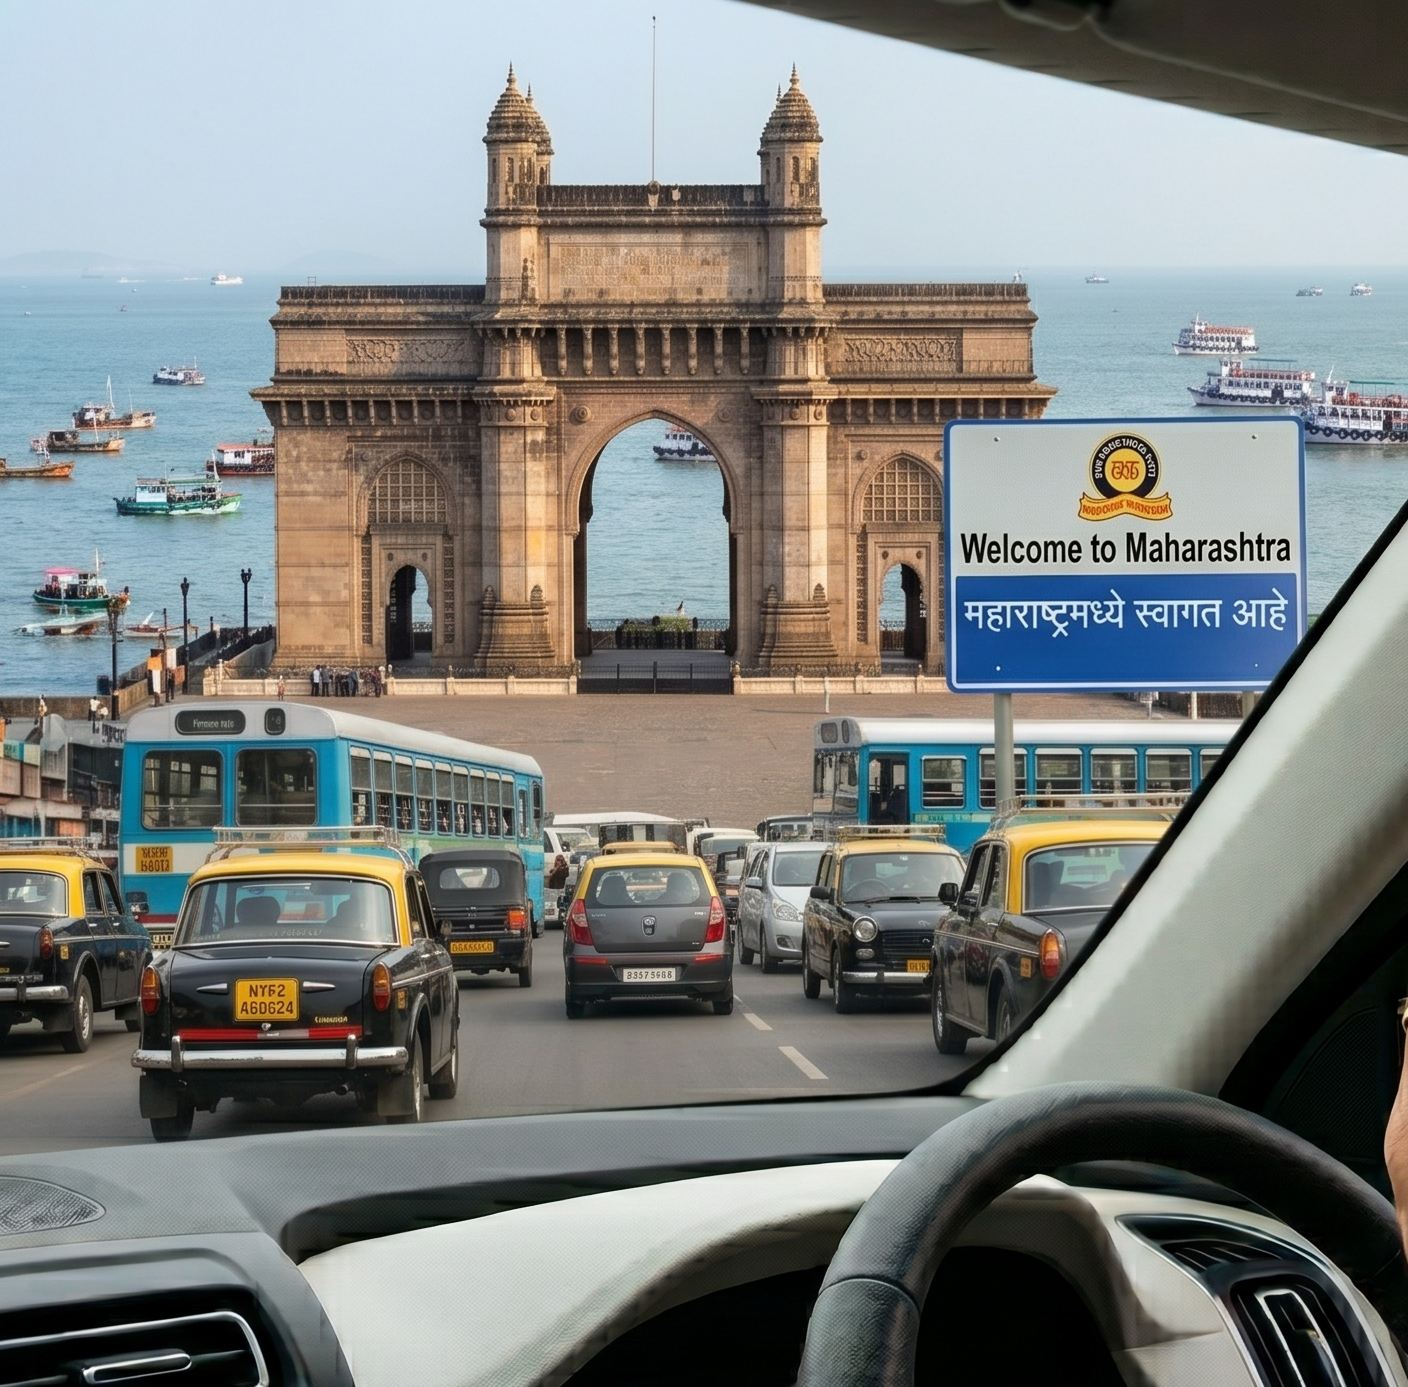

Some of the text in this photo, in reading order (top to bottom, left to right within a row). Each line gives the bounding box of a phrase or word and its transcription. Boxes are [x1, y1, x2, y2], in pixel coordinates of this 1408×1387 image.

[960, 531, 1291, 564] Welcome to Maharashtra
[964, 588, 1288, 638] महाराष्ट्रमध्ये स्वागत आहे
